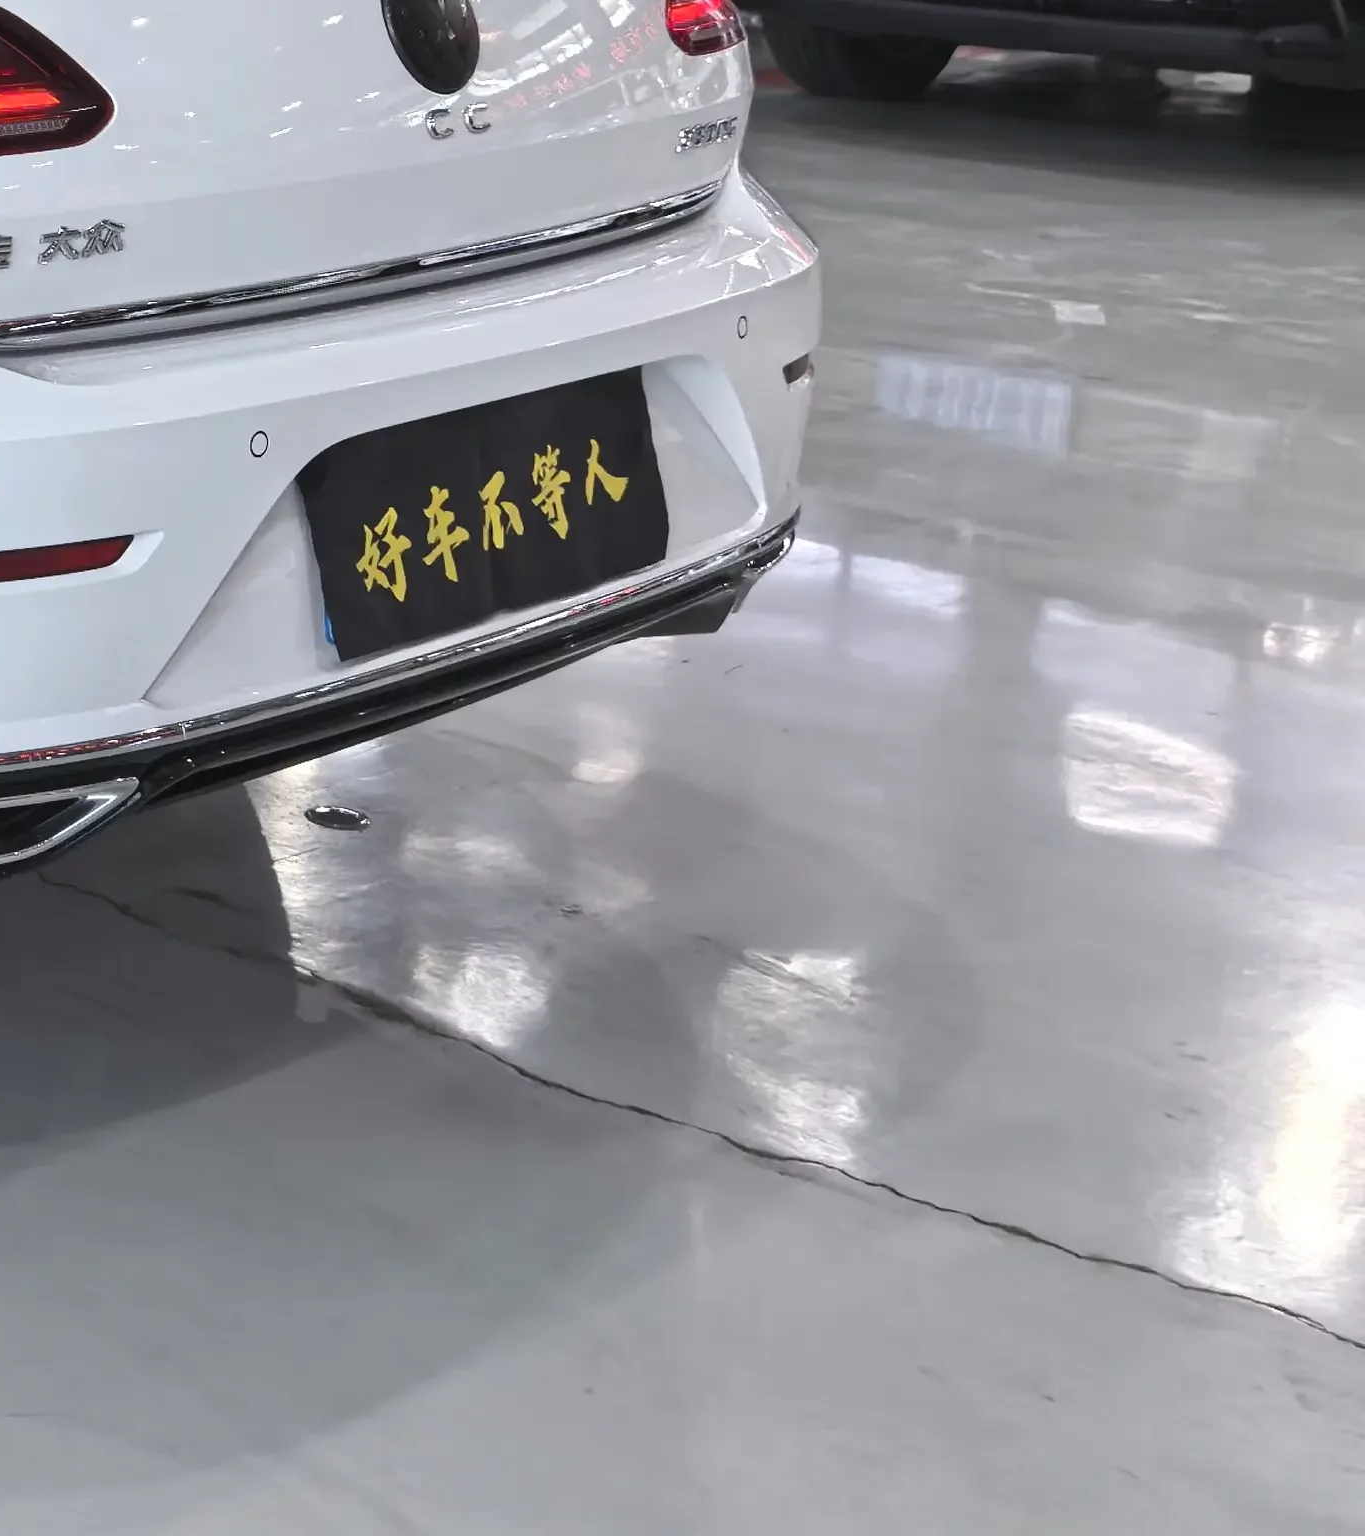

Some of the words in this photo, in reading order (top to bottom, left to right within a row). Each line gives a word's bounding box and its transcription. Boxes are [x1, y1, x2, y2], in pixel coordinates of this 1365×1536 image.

[37, 219, 126, 266] 大众
[355, 438, 630, 602] 好车不等人
